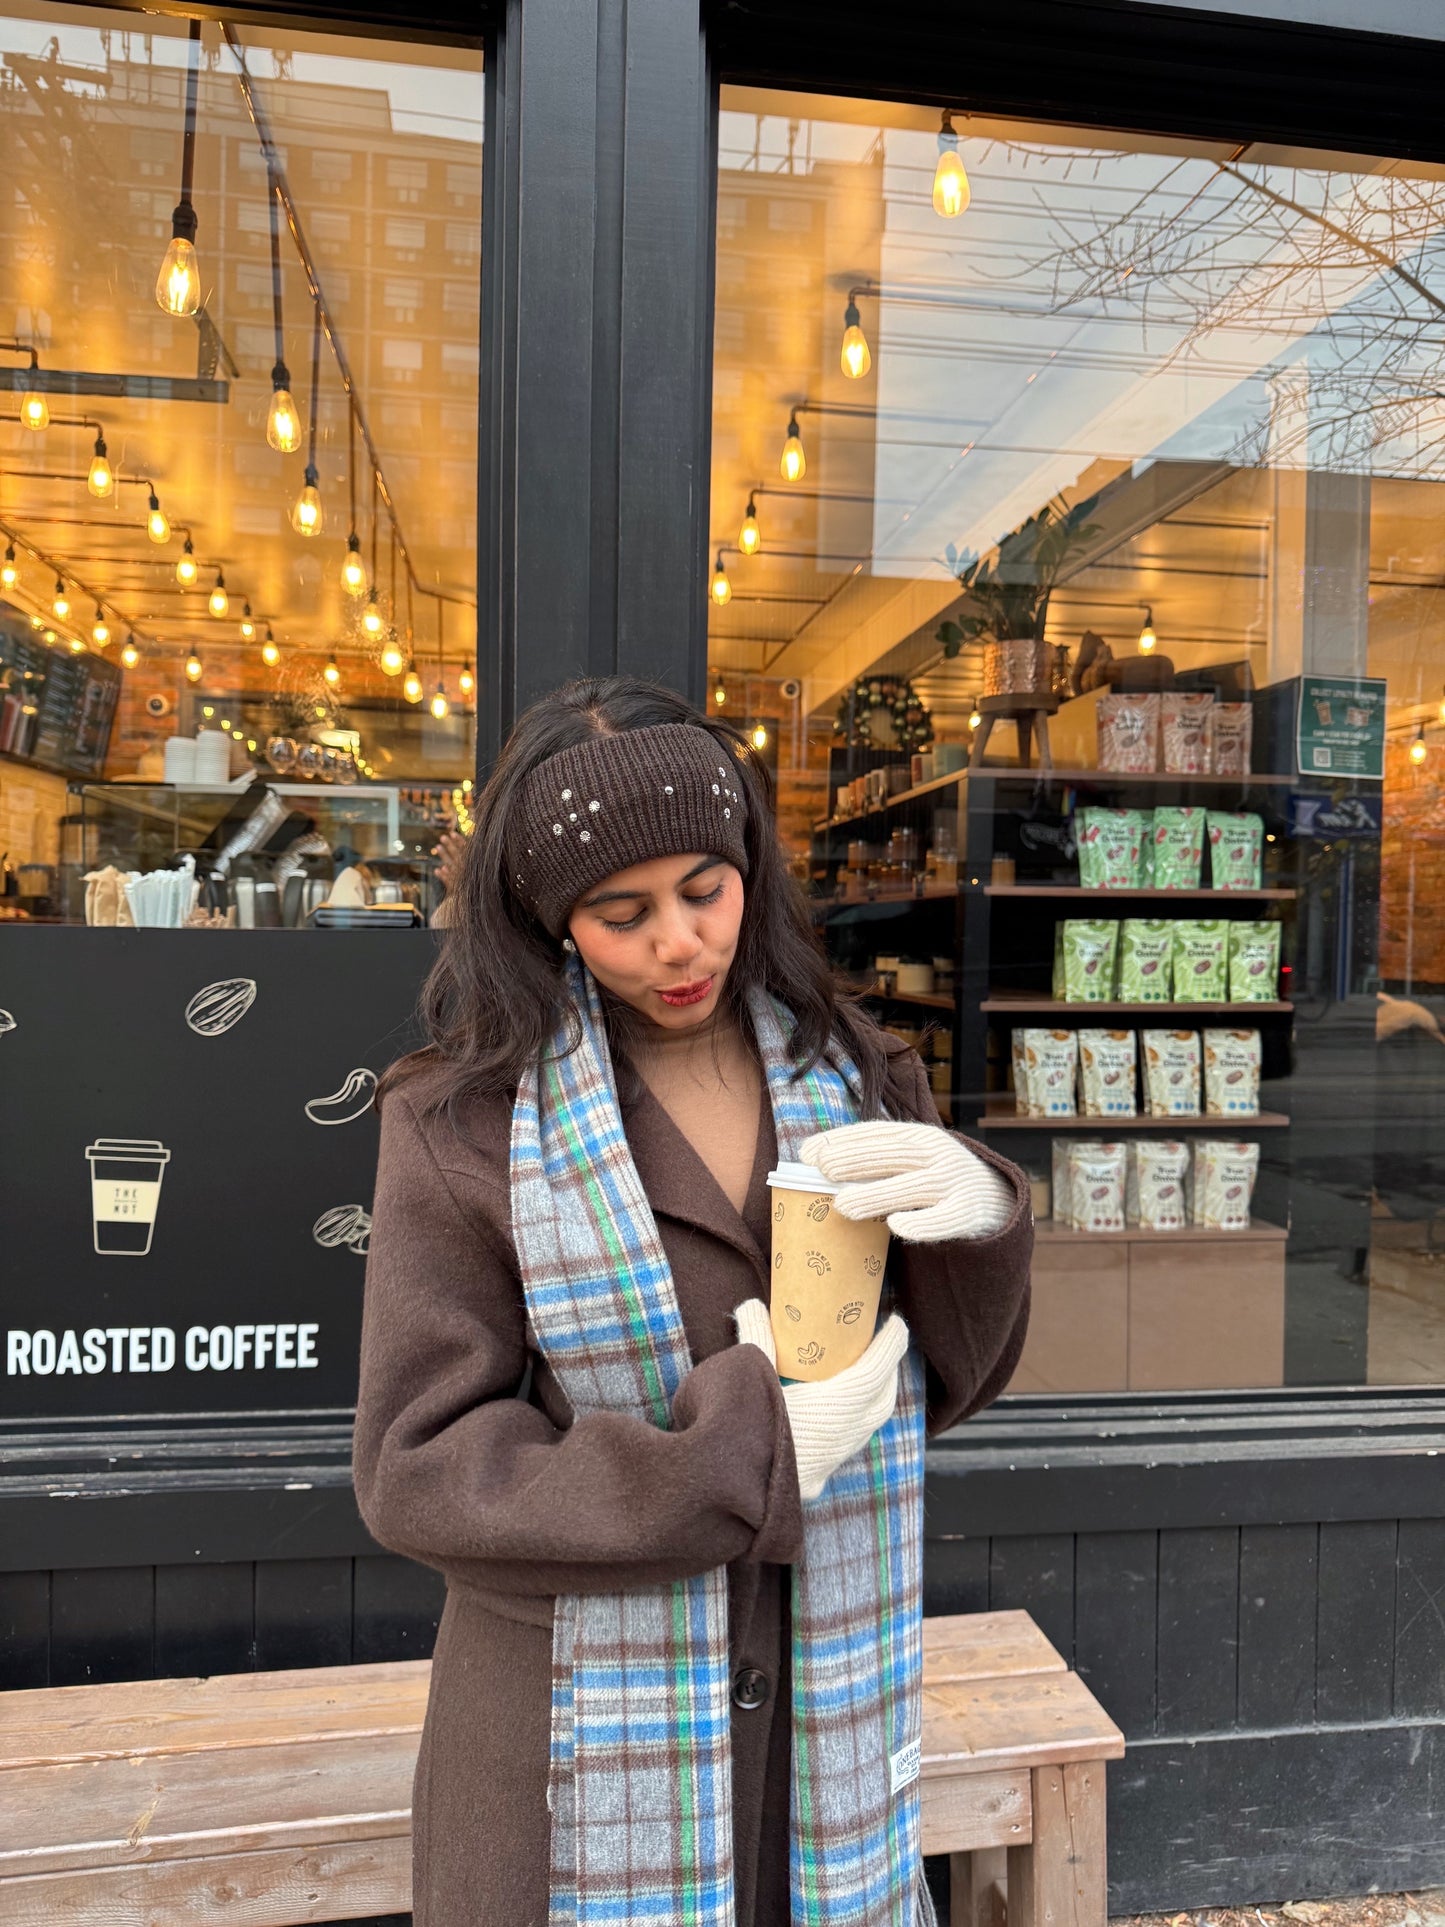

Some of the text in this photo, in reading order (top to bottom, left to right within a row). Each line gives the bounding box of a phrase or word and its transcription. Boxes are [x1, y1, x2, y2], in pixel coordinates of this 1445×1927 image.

[115, 1188, 137, 1198] THE
[114, 1204, 137, 1214] NUT
[7, 1323, 319, 1375] ROASTED COFFEE
